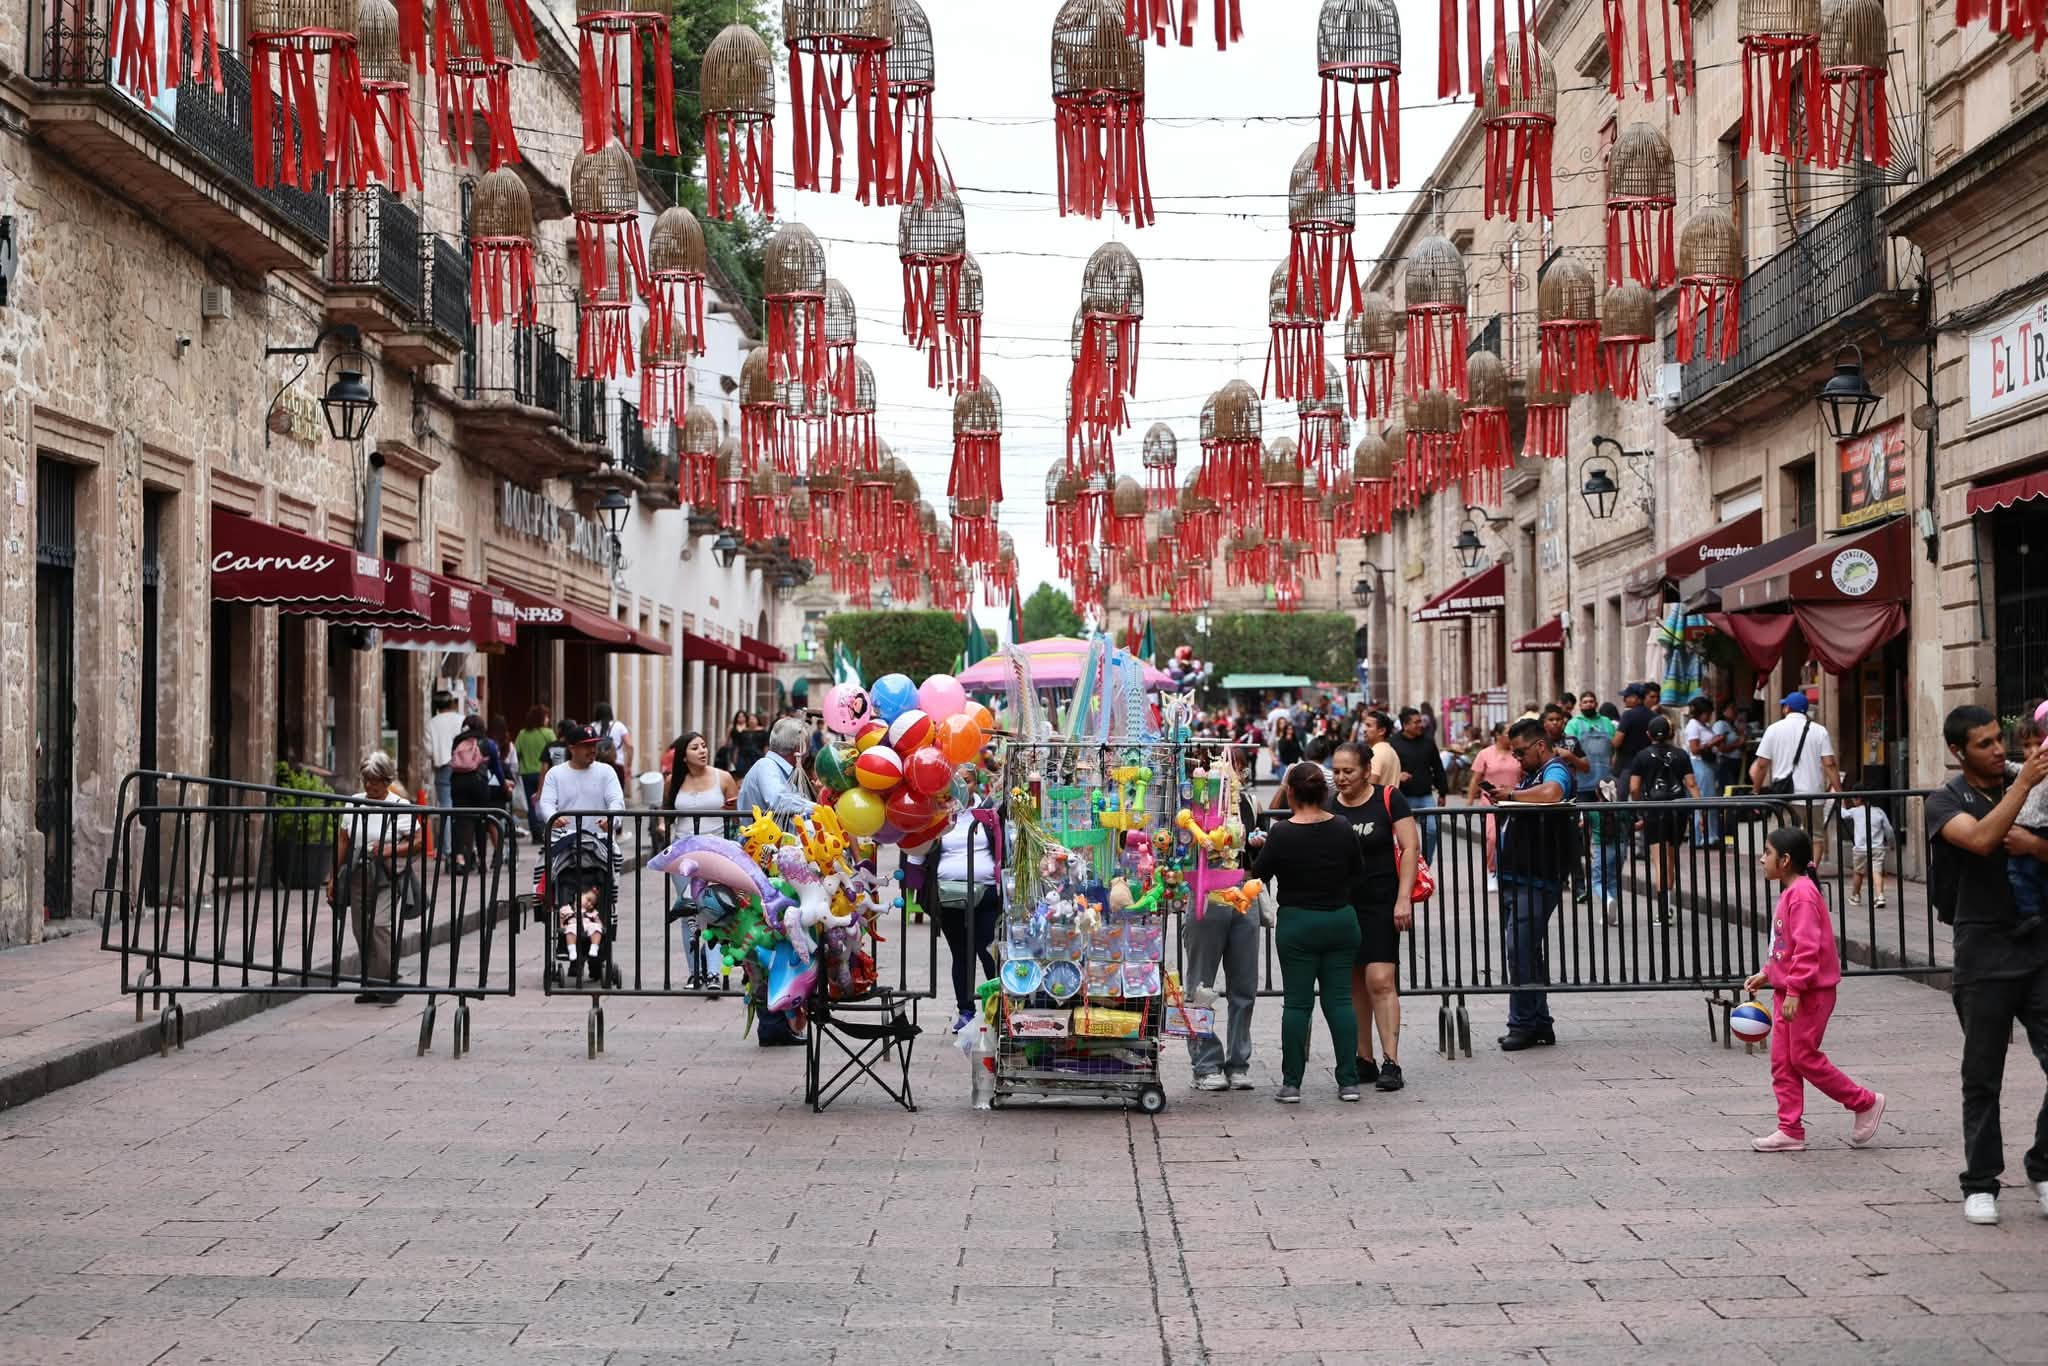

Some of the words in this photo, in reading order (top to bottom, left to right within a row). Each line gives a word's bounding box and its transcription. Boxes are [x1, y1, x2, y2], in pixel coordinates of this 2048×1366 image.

[1991, 335, 2016, 399] EL
[2018, 321, 2048, 386] TR
[212, 551, 335, 573] Carnes
